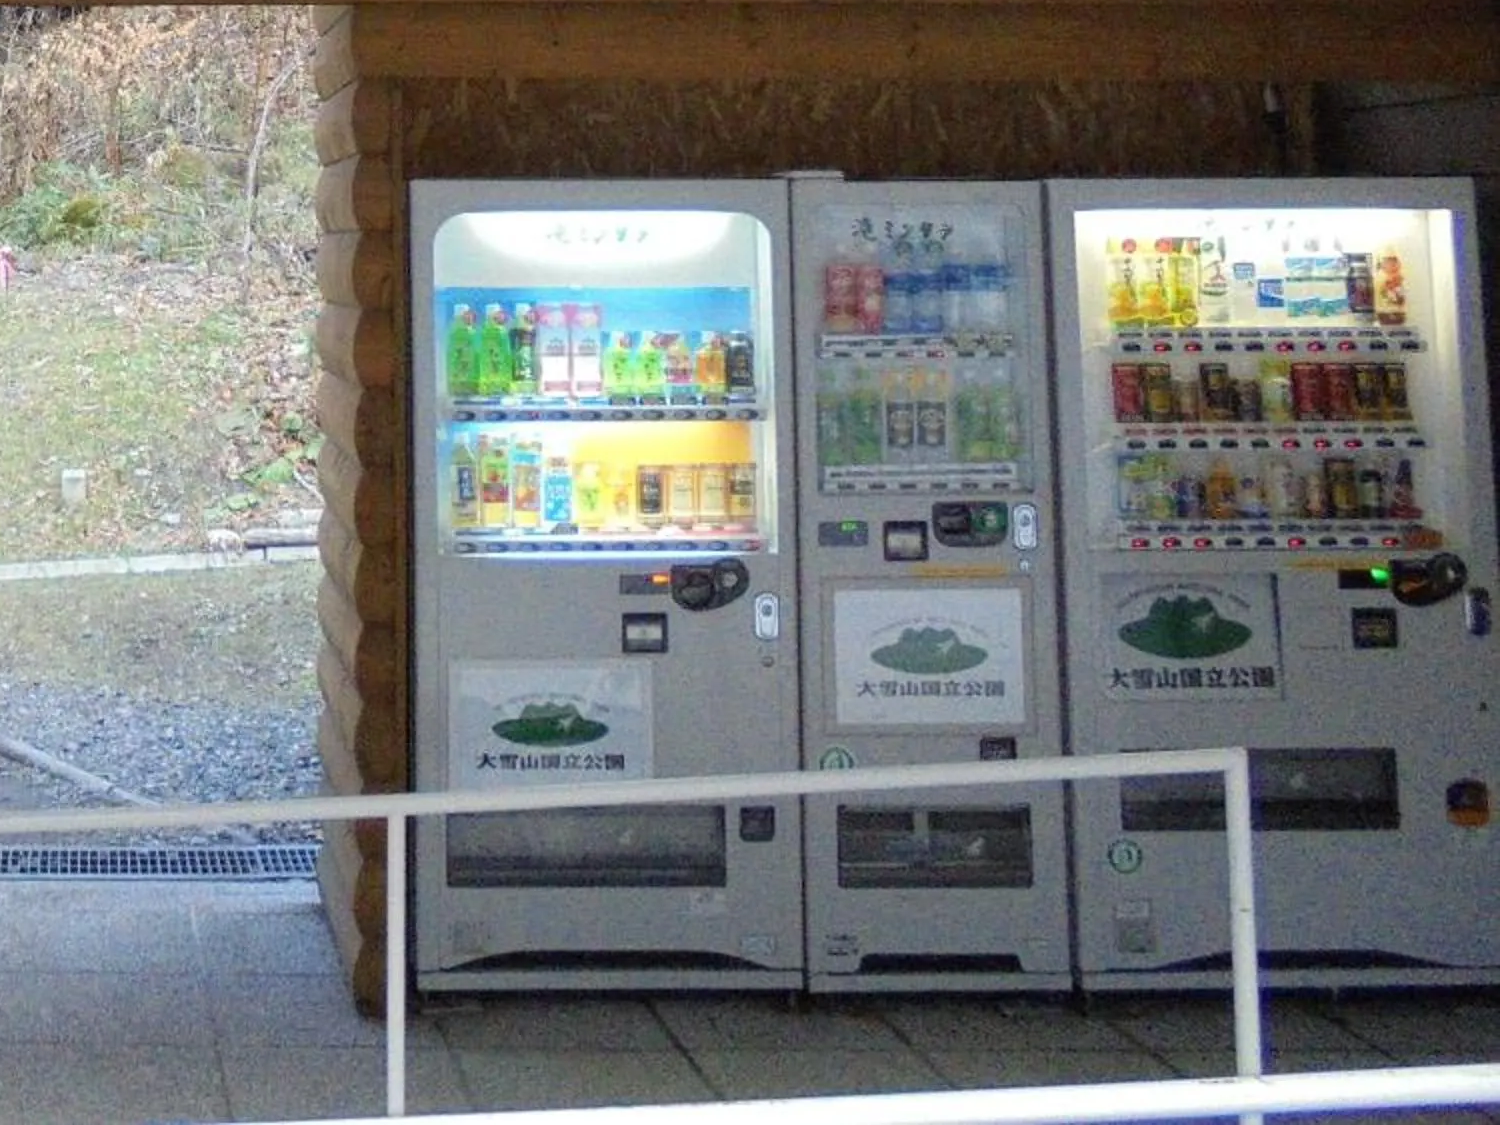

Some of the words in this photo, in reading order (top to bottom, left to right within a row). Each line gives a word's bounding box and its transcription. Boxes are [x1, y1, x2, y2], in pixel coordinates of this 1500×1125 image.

[1108, 665, 1276, 689] 大雪山国立公園
[855, 679, 1006, 698] 大雪山国立公園
[475, 752, 626, 772] 大雪山国立公園
